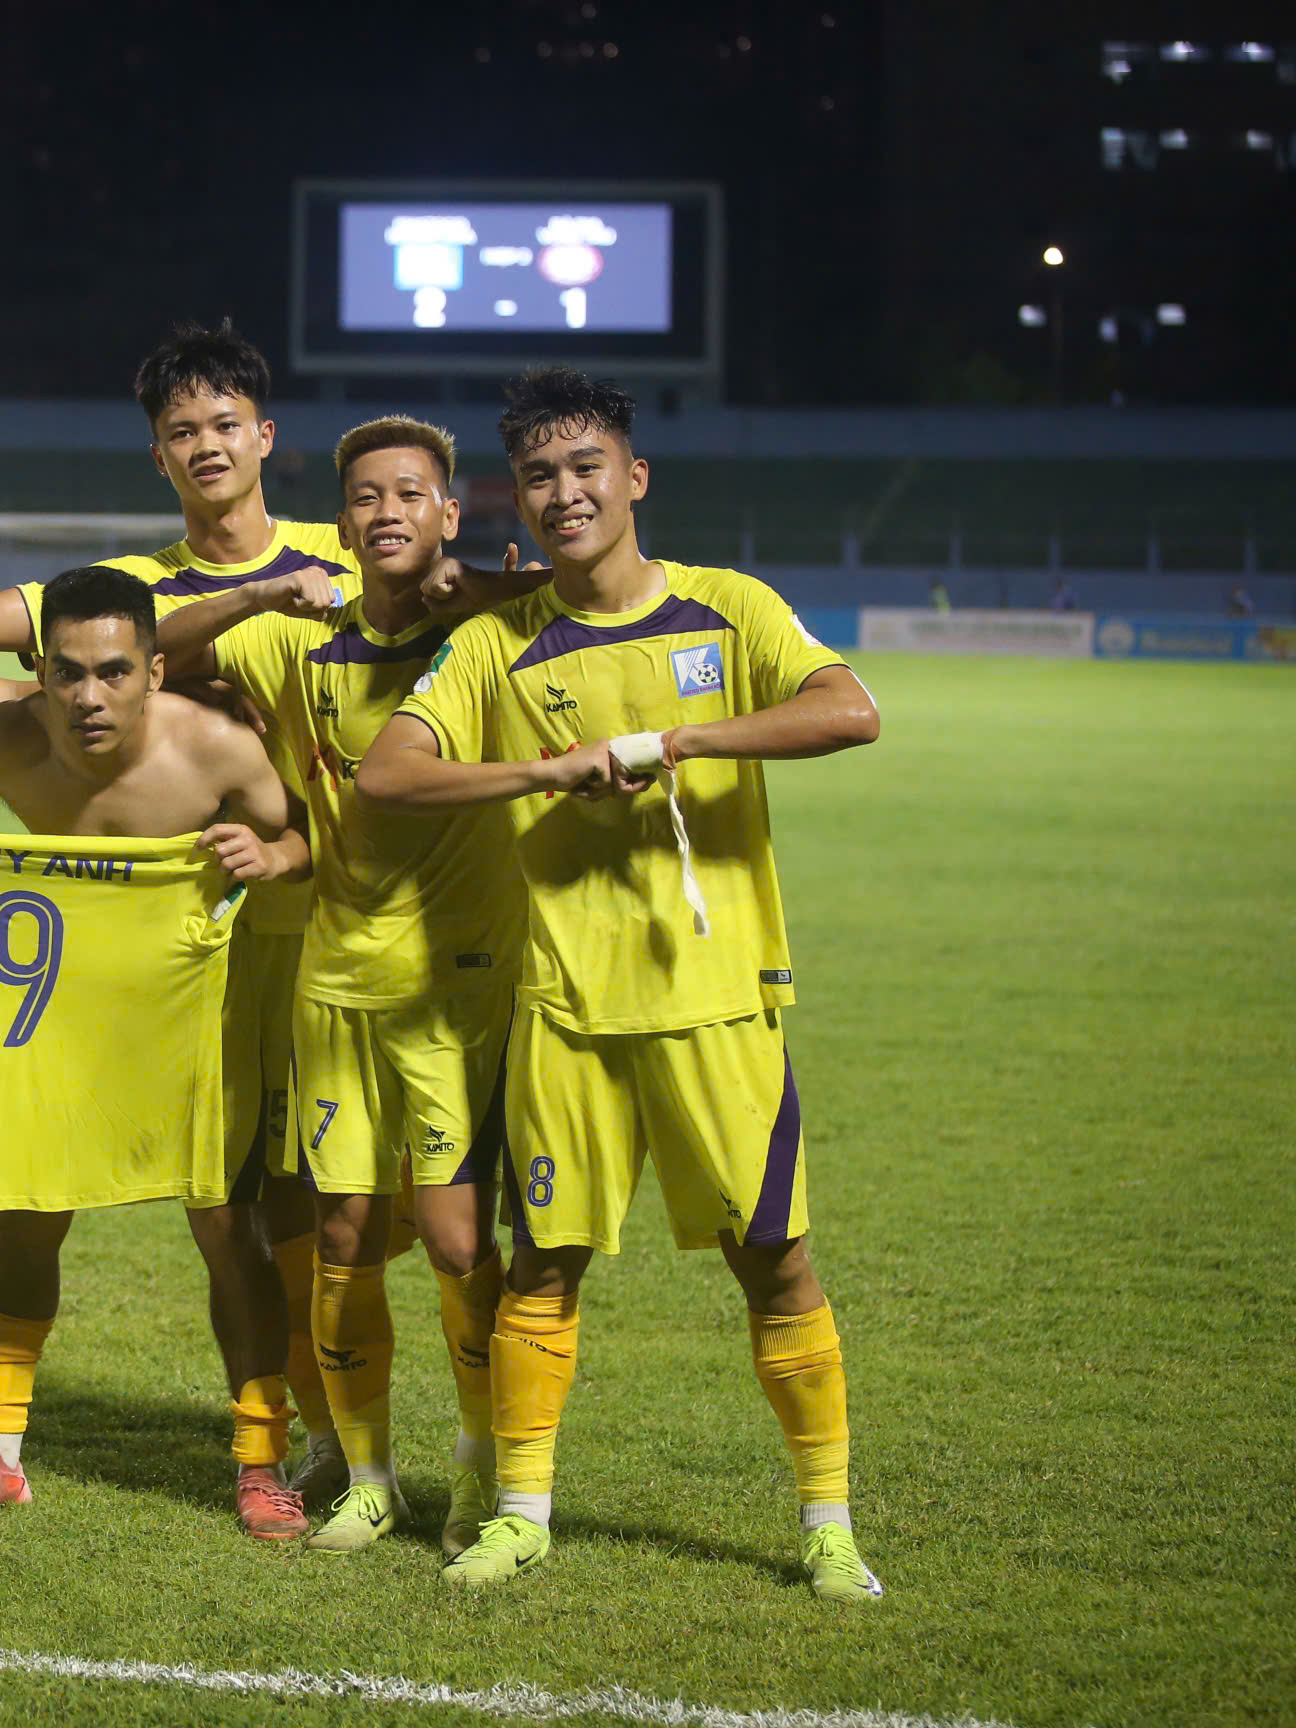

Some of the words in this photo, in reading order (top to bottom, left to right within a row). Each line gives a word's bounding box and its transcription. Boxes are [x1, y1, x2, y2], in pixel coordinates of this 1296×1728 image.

[545, 700, 578, 712] KAMITO
[41, 855, 135, 882] ANH
[311, 1098, 339, 1150] 7
[425, 1142, 455, 1153] KAMITO
[527, 1155, 555, 1208] 8
